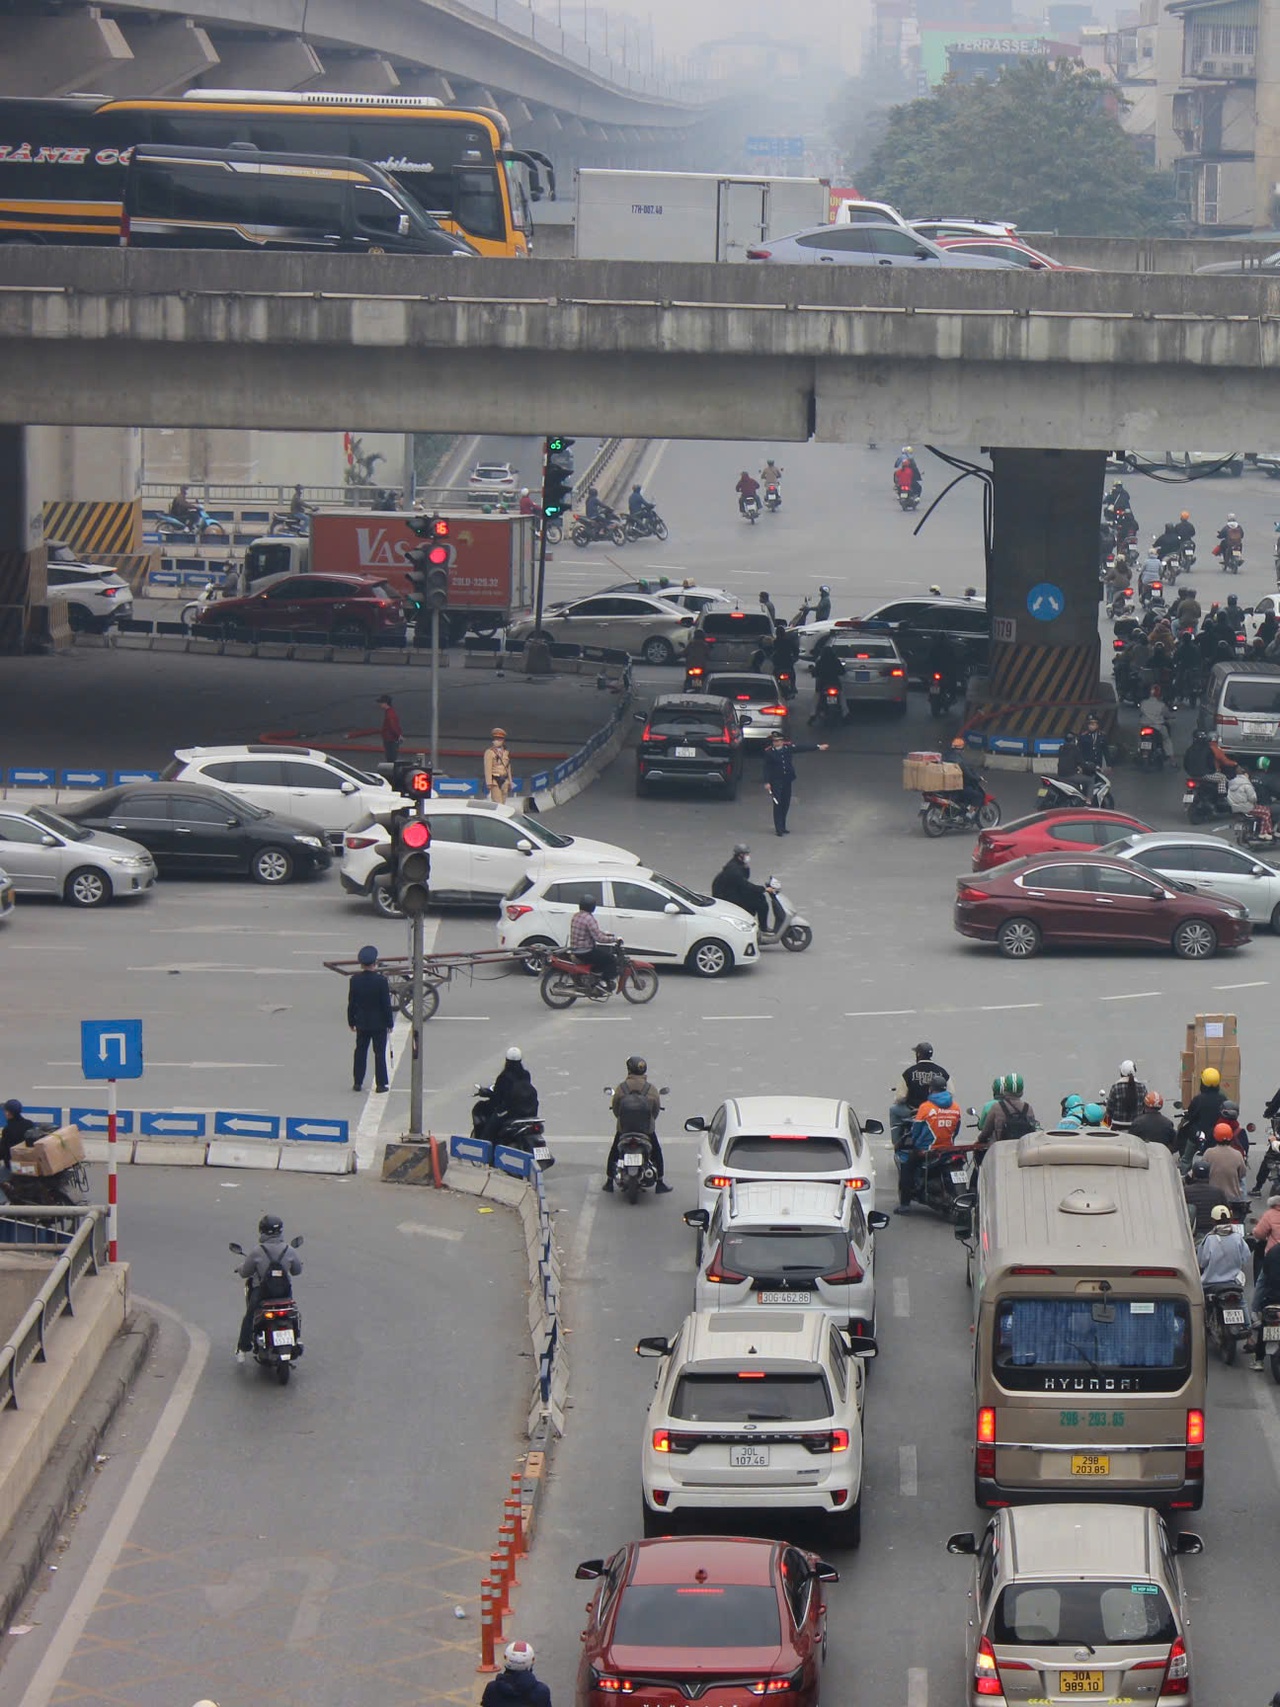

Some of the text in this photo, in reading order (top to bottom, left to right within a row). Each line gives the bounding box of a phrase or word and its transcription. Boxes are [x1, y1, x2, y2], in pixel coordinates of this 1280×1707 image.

[435, 521, 448, 534] 16
[414, 773, 430, 791] 16
[1045, 1378, 1140, 1390] HYUNDAI
[742, 1447, 758, 1456] 30L
[736, 1456, 765, 1465] 107.46
[1083, 1457, 1099, 1465] 29B
[1075, 1465, 1106, 1474] 203.85
[1071, 1672, 1091, 1681] 30A
[1064, 1682, 1099, 1691] 989.10
